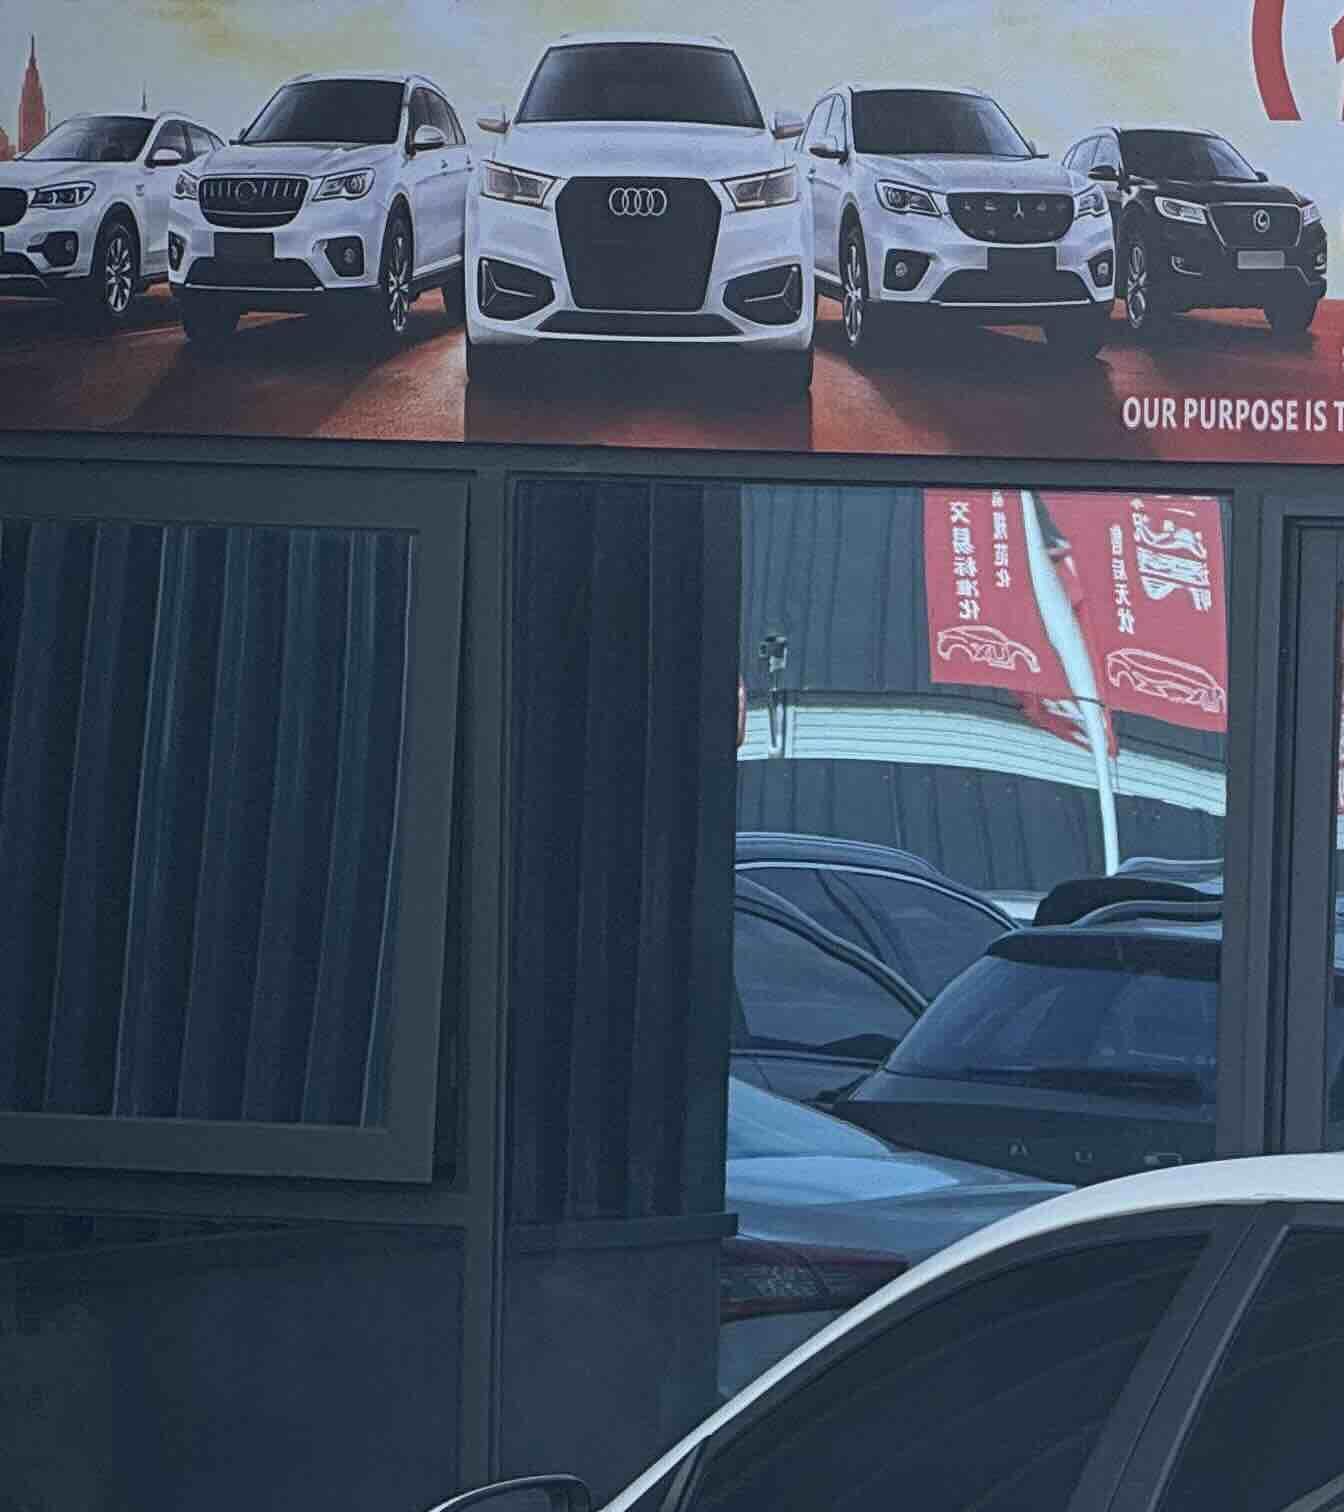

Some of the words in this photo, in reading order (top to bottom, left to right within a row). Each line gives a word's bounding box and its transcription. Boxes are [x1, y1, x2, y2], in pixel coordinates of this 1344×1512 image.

[1123, 396, 1177, 430] OUR
[1184, 398, 1298, 433] PURPOSE
[1305, 401, 1327, 432] IS
